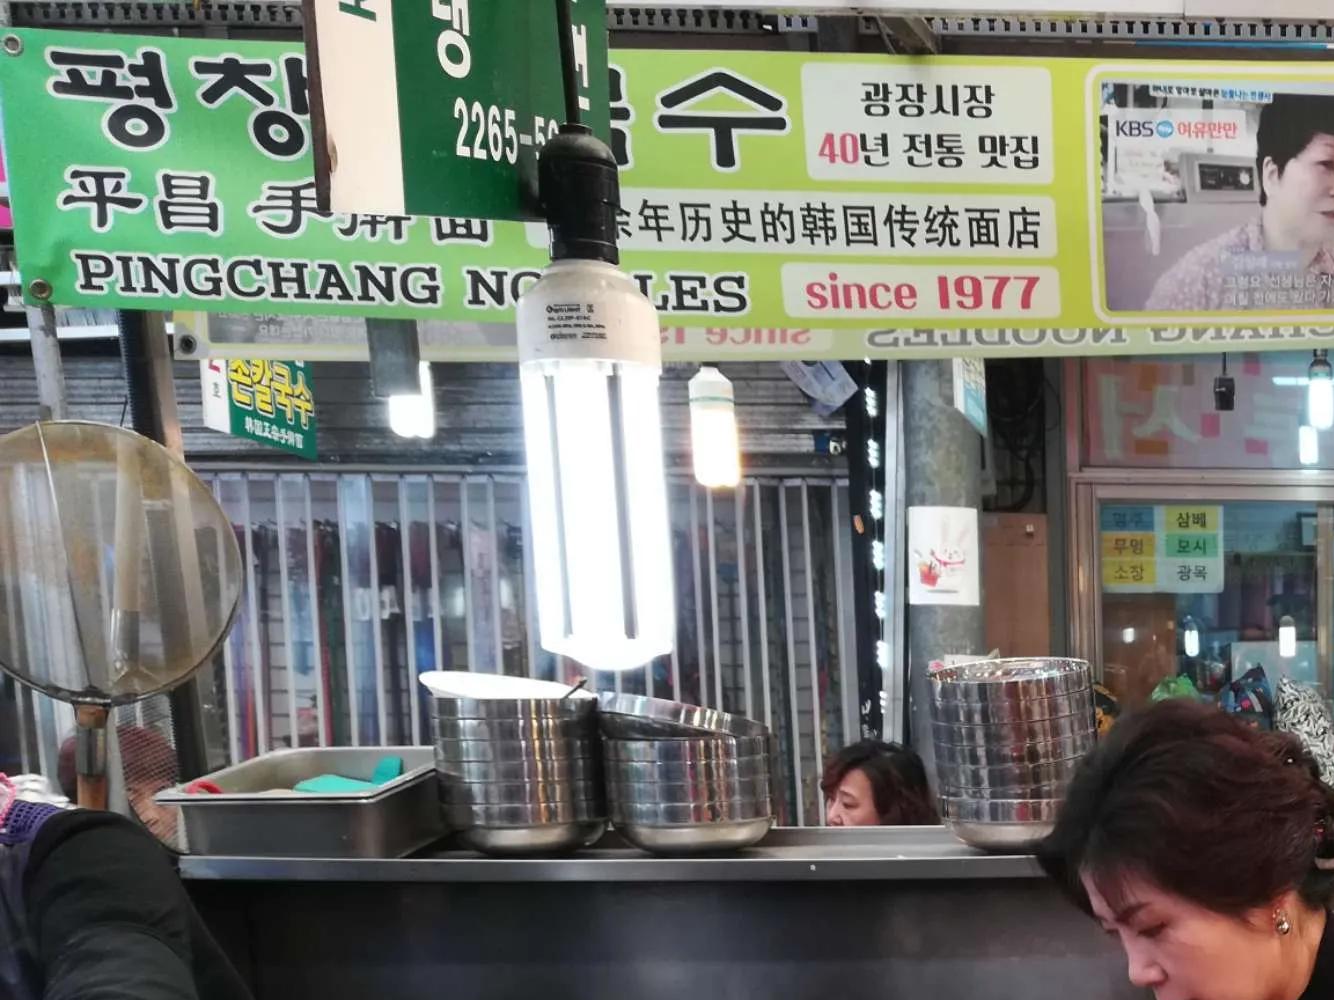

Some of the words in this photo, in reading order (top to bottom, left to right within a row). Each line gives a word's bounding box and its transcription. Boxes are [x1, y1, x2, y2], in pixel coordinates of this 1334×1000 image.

[860, 83, 996, 118] 광장시장
[1115, 121, 1154, 138] KBS
[818, 132, 890, 167] 40년
[902, 134, 966, 168] 전통
[978, 135, 1040, 170] 맛집
[74, 253, 440, 305] PINGCHANG
[806, 272, 917, 311] since
[938, 275, 1040, 311] 1977
[1176, 512, 1207, 529] 삼베
[1176, 538, 1207, 555] 모시
[1176, 564, 1208, 581] 광목
